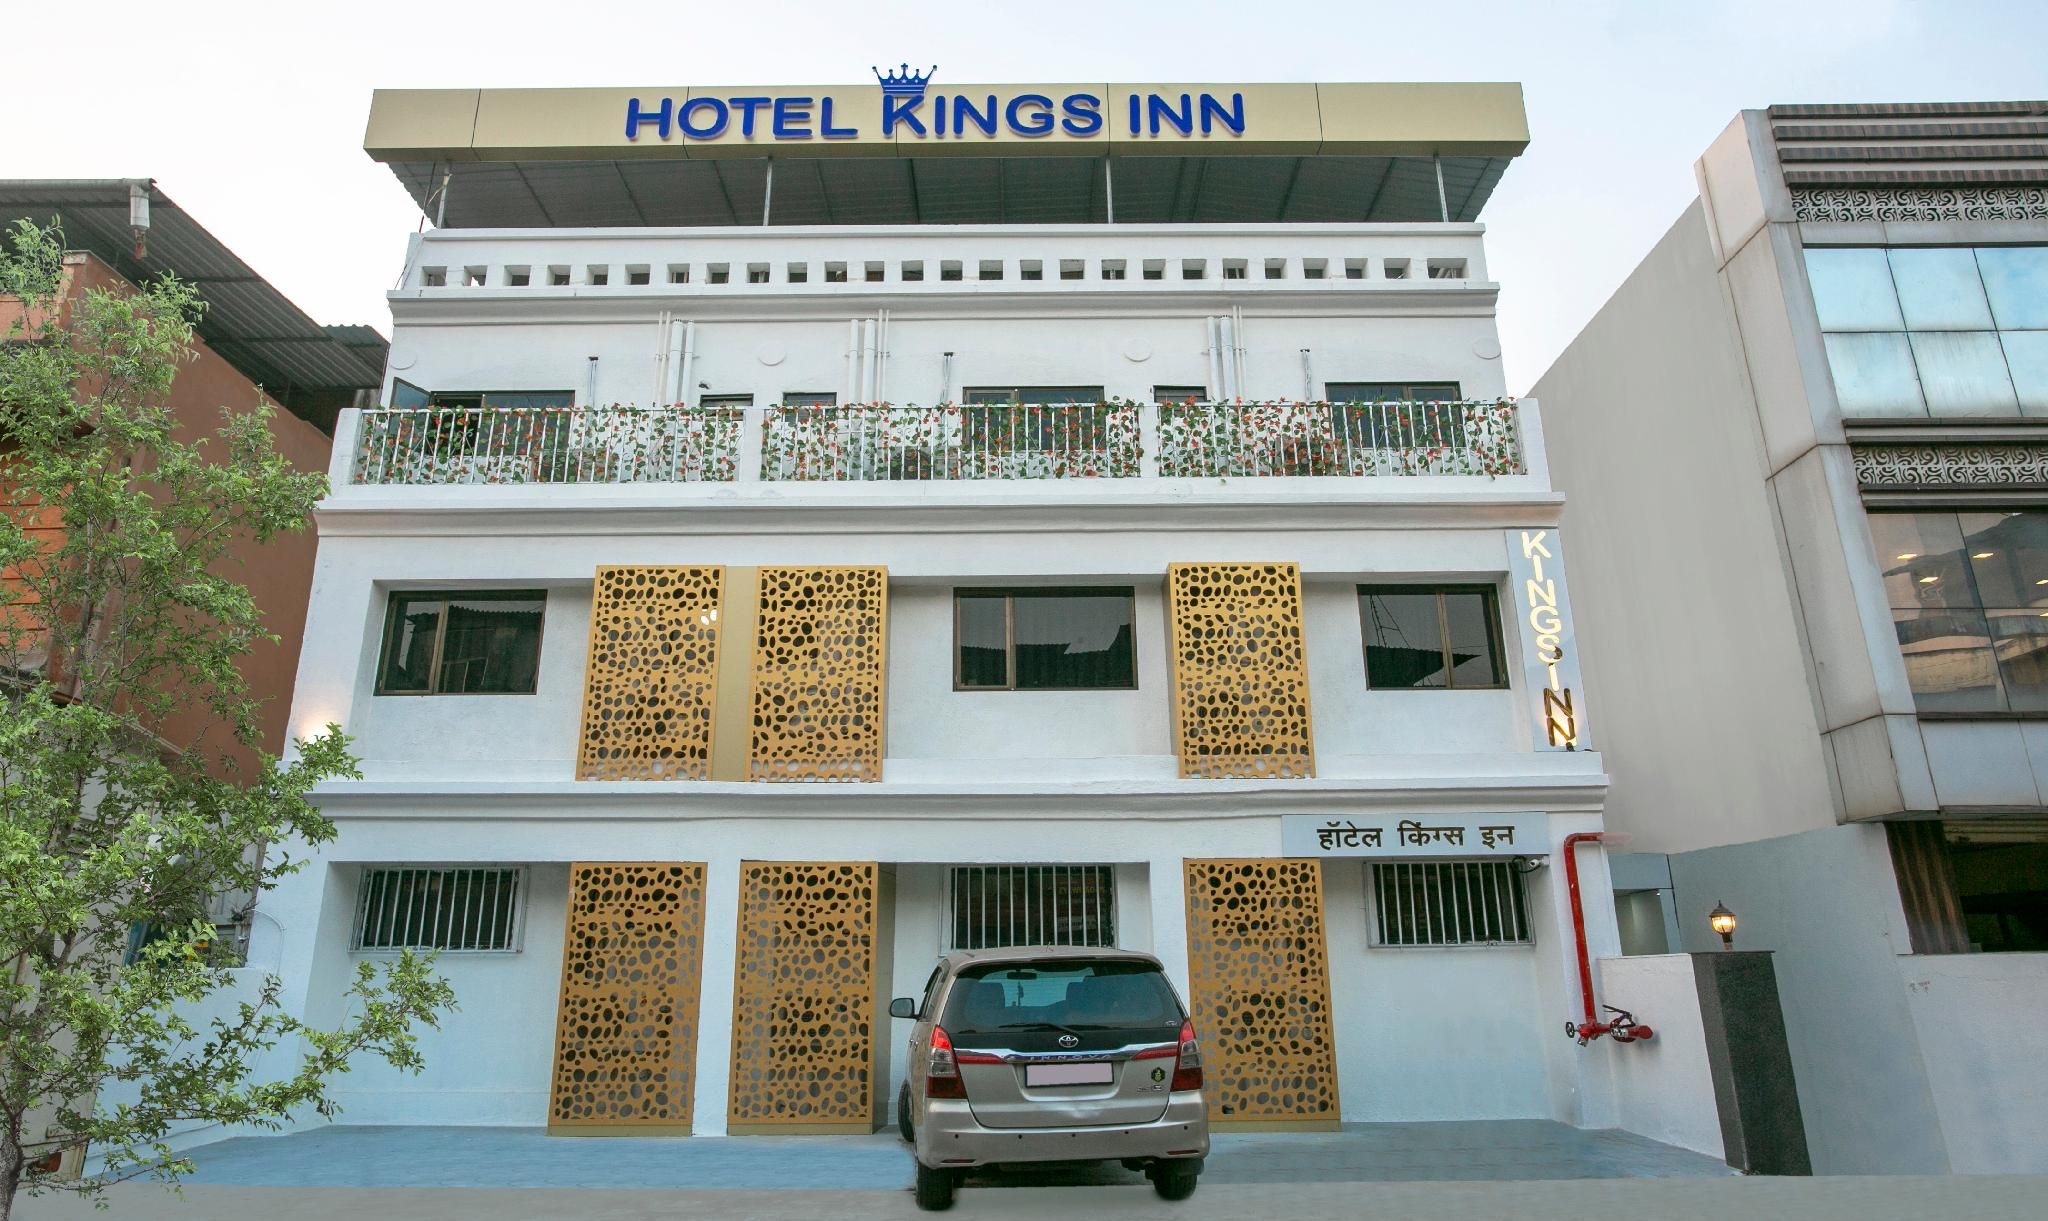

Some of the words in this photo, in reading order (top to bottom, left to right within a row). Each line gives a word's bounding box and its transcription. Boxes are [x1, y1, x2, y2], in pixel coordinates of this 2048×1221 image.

[626, 97, 856, 137] HOTEL
[883, 94, 1102, 135] KINGS
[1130, 94, 1244, 134] INN
[1521, 531, 1563, 663] KINGS
[1543, 662, 1576, 747] INN
[1317, 821, 1383, 850] हॉटेल
[1397, 820, 1465, 846] किंग्स
[1479, 826, 1515, 849] इन
